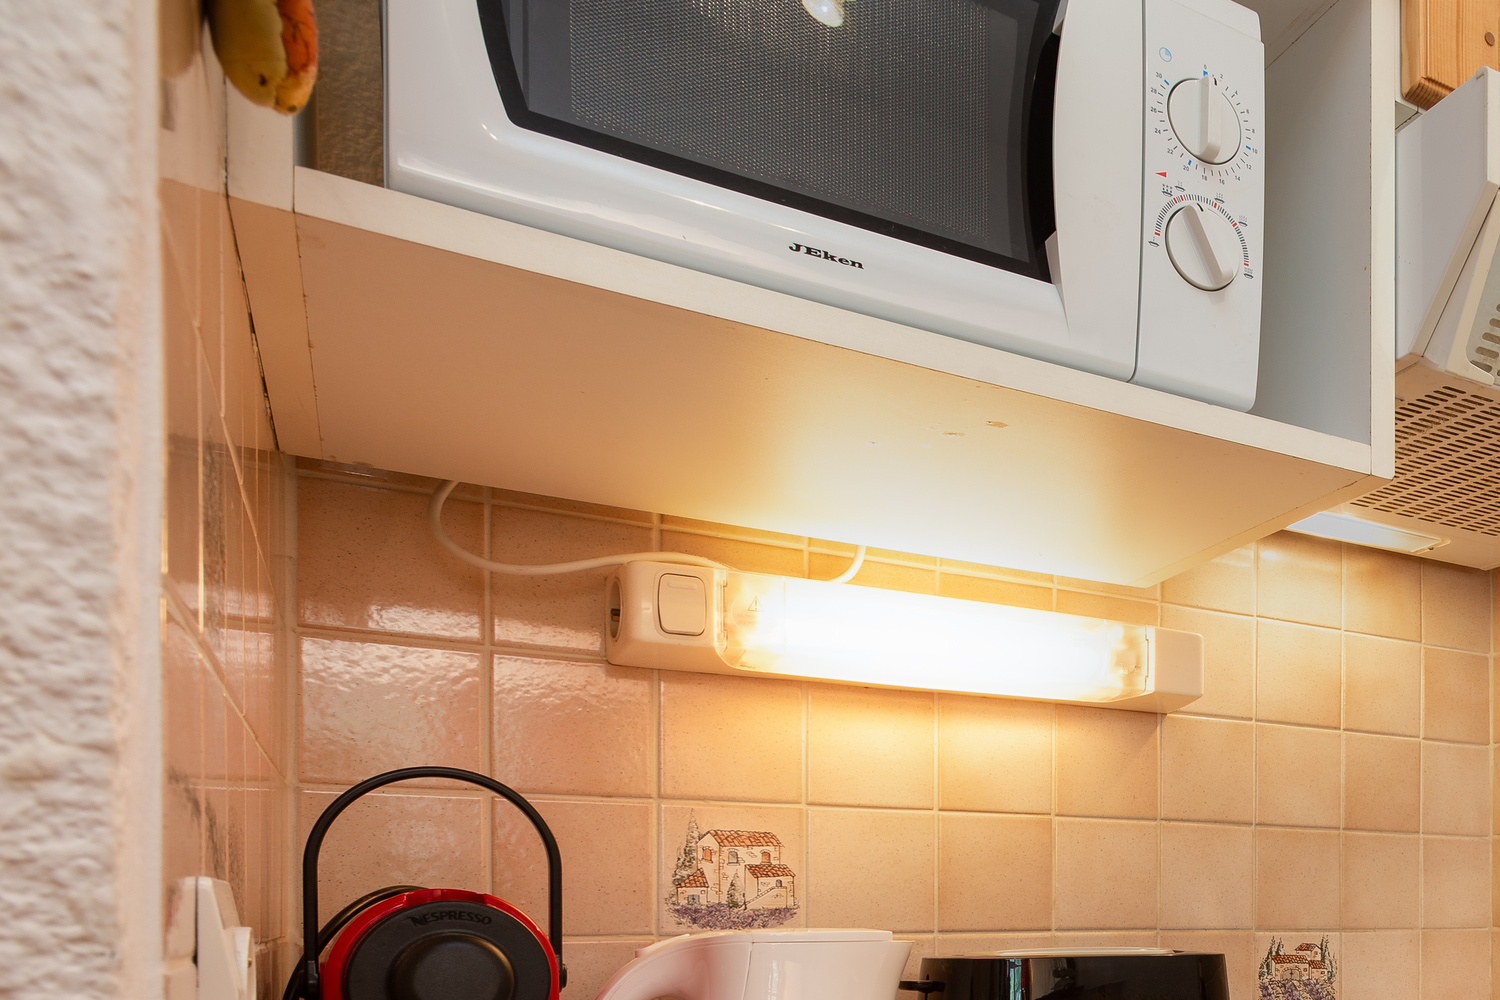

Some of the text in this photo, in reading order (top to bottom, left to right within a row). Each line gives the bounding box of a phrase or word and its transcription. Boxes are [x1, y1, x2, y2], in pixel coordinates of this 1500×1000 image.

[1150, 87, 1157, 95] 28
[1154, 127, 1161, 135] 24
[1252, 147, 1258, 155] 10
[788, 242, 865, 270] JEken
[406, 910, 493, 926] NESPRESSO
